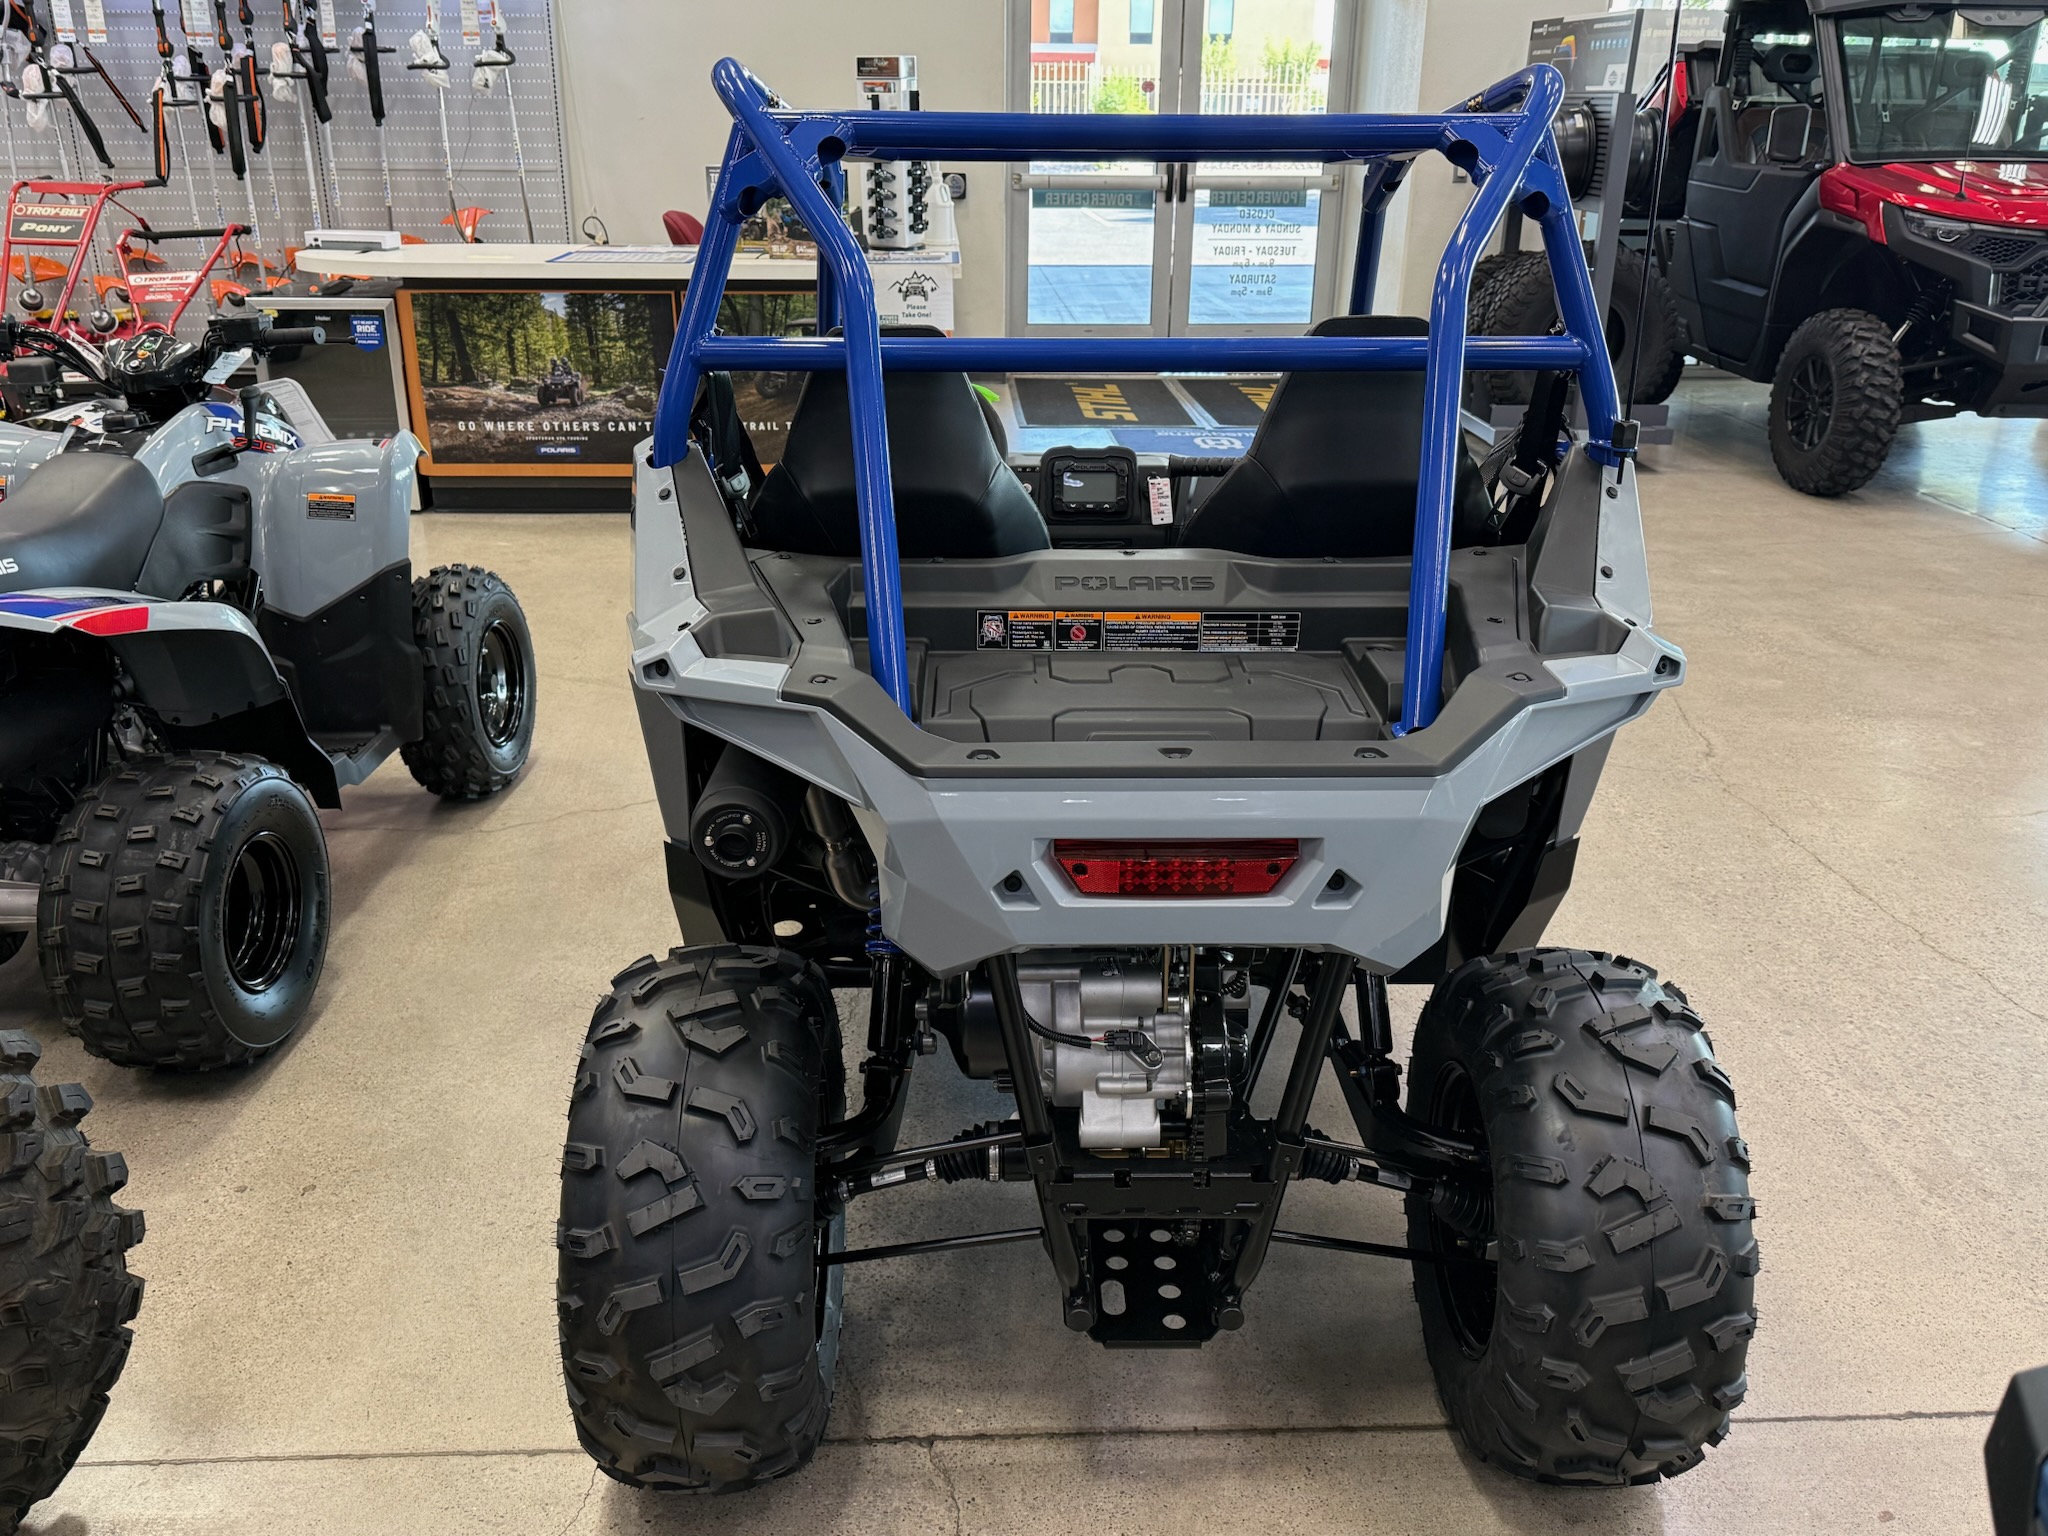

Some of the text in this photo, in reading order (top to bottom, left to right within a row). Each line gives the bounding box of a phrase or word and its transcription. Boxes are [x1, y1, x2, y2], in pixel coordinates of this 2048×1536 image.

[26, 206, 87, 217] TROY-BILT
[143, 275, 190, 283] TROY-BILT
[356, 325, 377, 333] RIDE
[458, 421, 652, 431] GO WHERE OTHERS CAN'T
[743, 421, 779, 431] TRAIL
[204, 416, 298, 449] PHENIX
[1054, 575, 1216, 593] POLARIS
